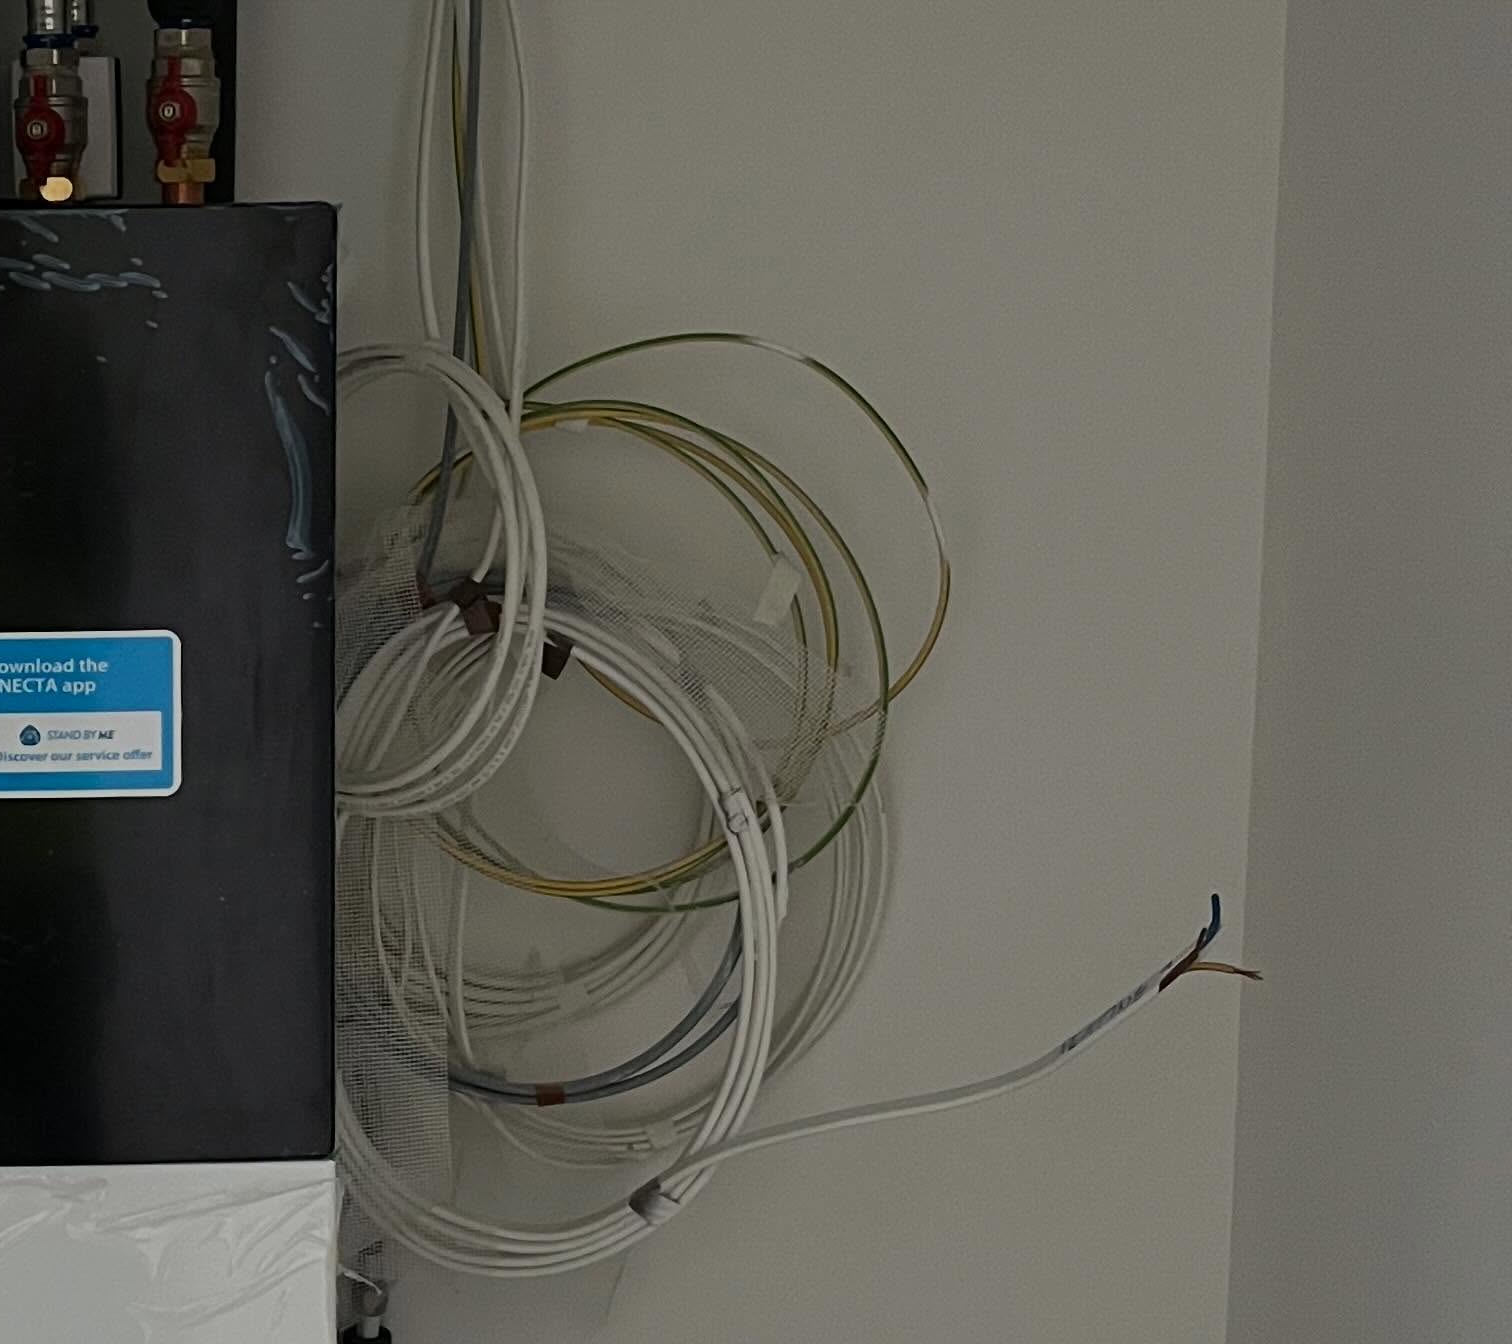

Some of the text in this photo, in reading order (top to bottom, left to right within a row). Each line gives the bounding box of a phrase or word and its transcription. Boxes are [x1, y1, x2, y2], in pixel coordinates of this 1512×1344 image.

[79, 657, 109, 673] the
[62, 681, 96, 695] app
[47, 729, 116, 740] STAND BY ME
[50, 752, 73, 761] our
[76, 750, 120, 761] service
[122, 749, 153, 761] offer
